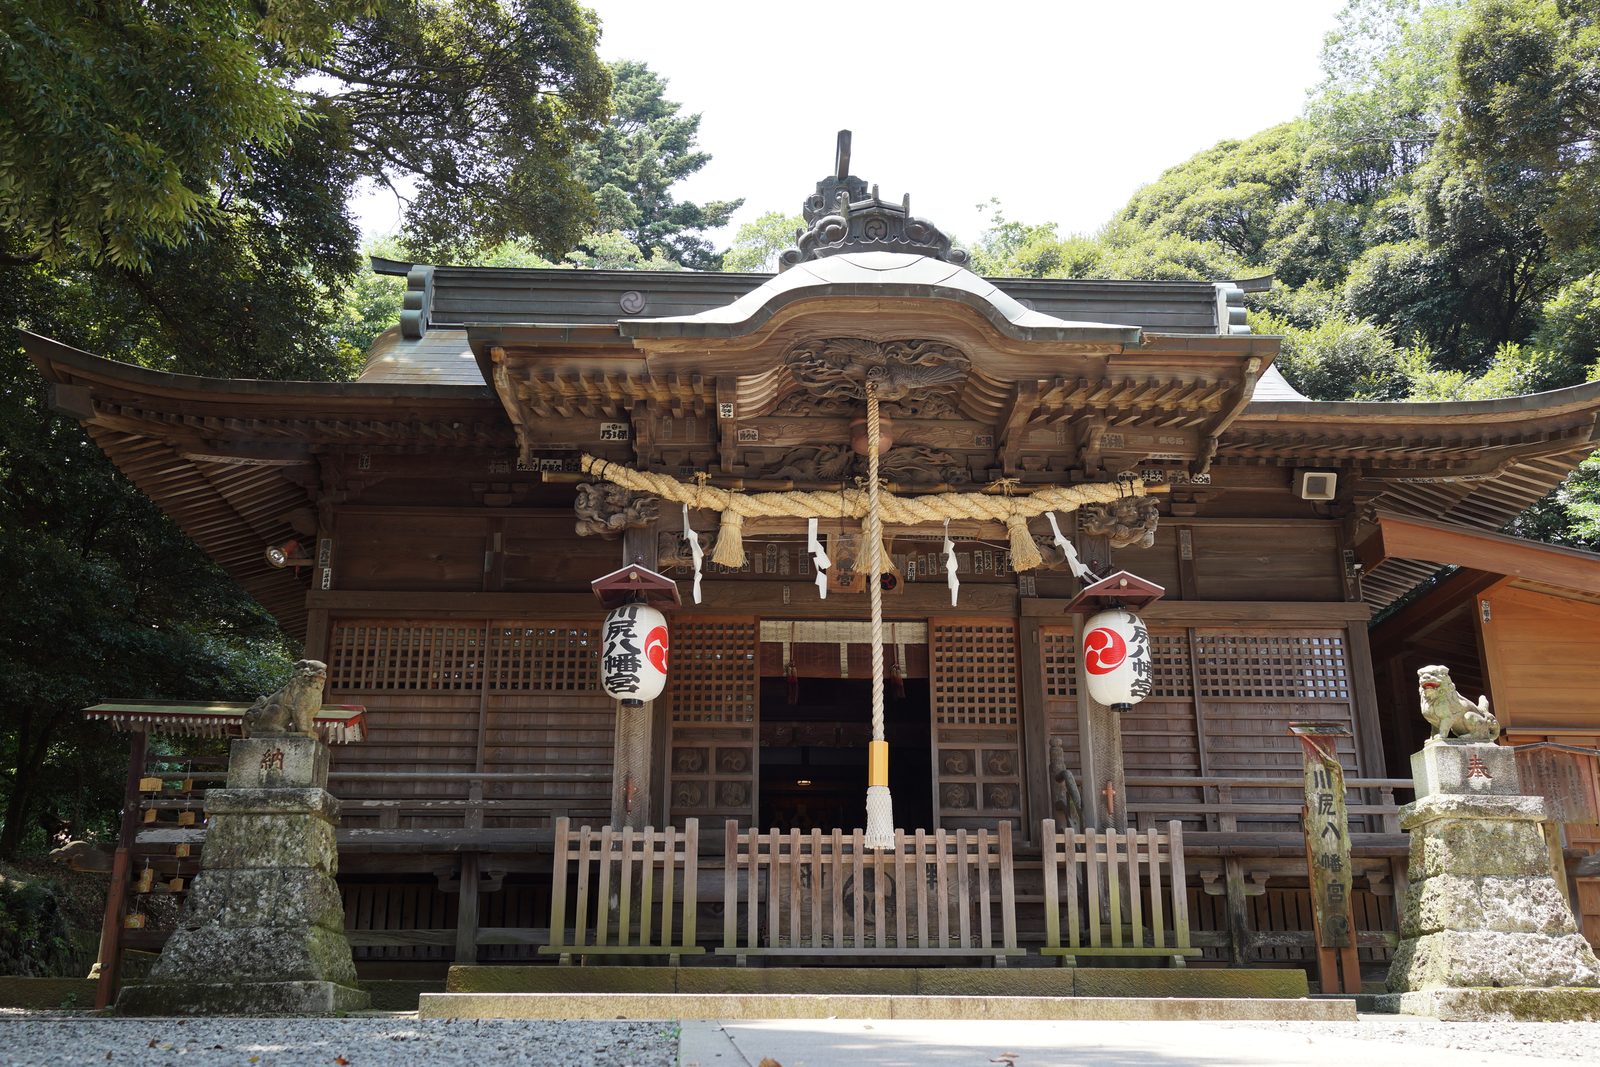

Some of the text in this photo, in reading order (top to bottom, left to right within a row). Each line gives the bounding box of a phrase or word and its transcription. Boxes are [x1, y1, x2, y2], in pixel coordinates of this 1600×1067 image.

[603, 606, 642, 694] 川尻八幡宮
[260, 748, 285, 777] 納
[1466, 754, 1494, 782] 奉
[1314, 770, 1345, 905] 川尻八幡宮
